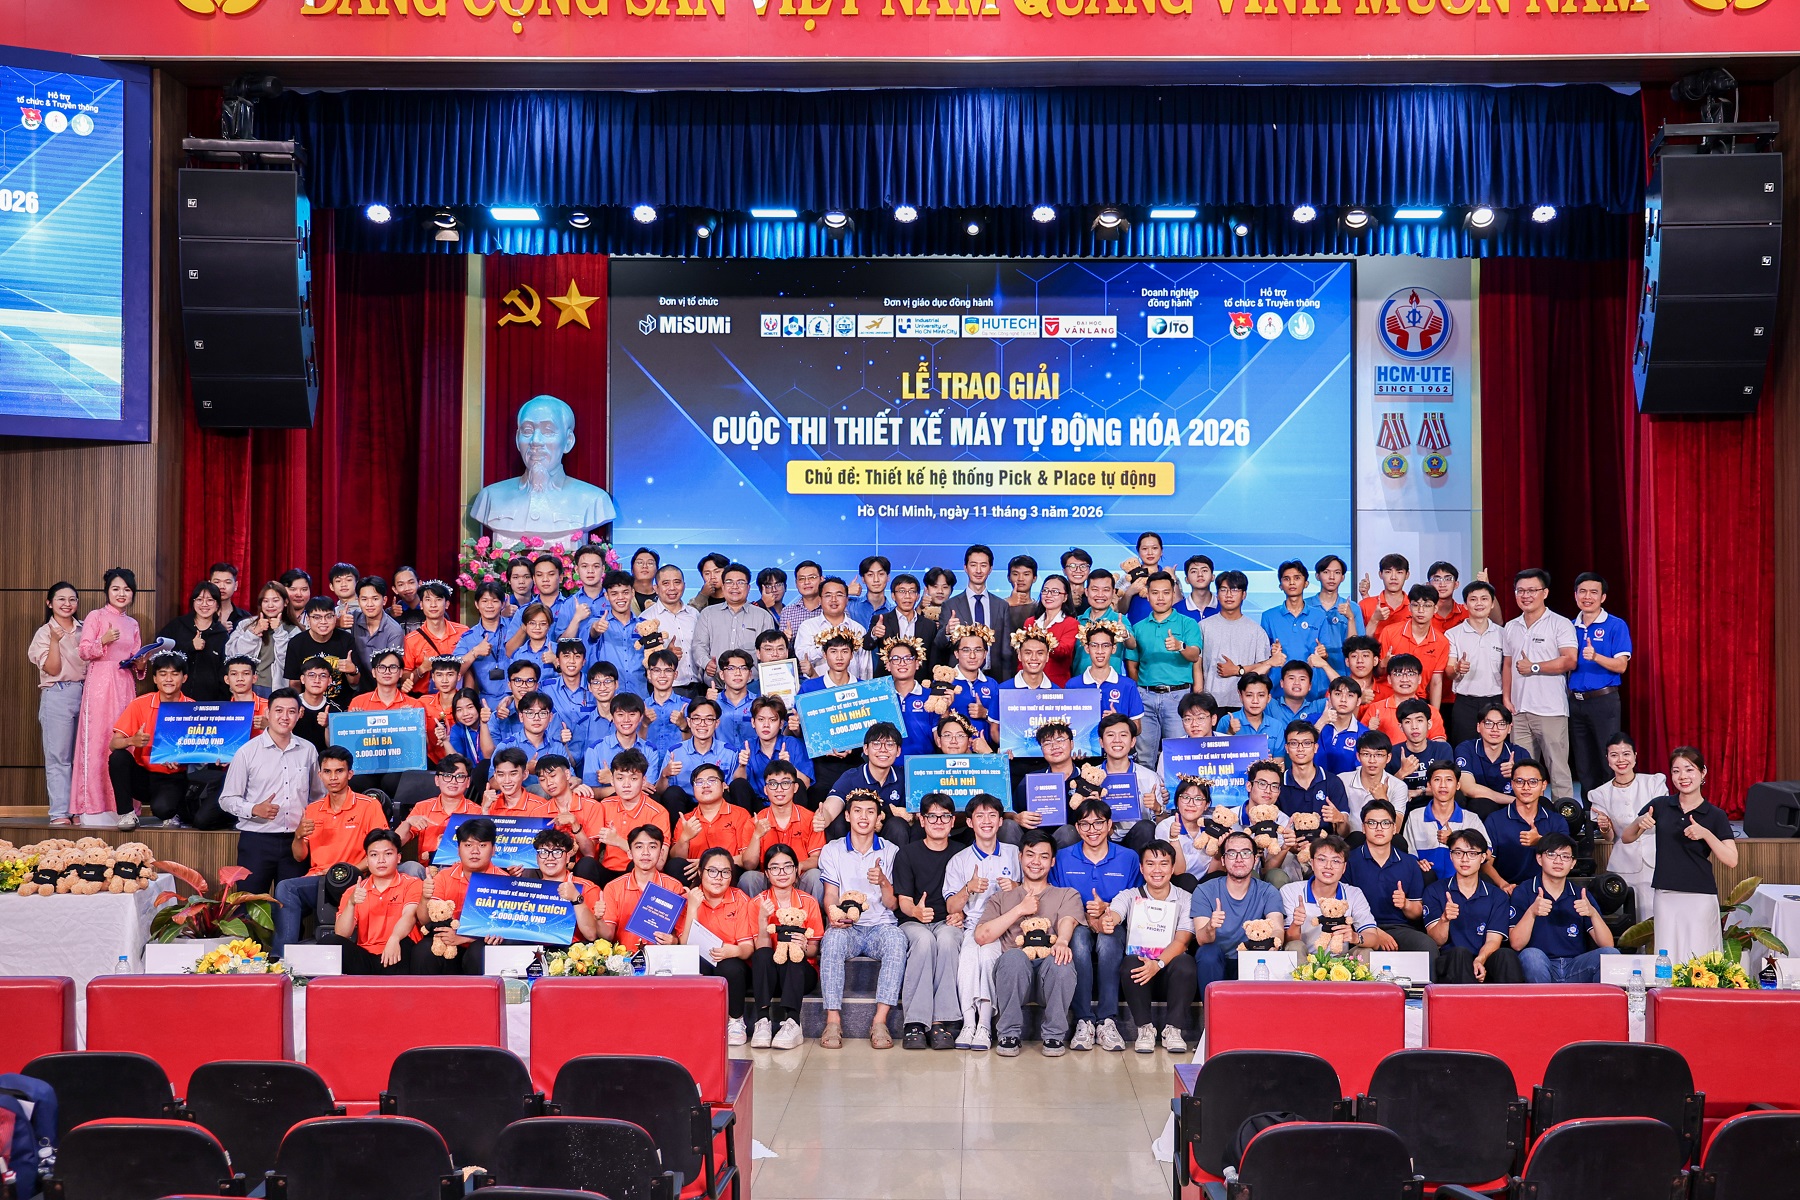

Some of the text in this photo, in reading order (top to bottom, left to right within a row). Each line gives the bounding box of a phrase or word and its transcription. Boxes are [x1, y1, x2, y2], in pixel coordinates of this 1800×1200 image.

[1142, 288, 1199, 299] Doanh nghiệp
[1274, 289, 1287, 299] trợ
[659, 296, 718, 307] Đơn vị tổ chức
[884, 297, 994, 308] Đơn vị giáo dục đồng hành
[1148, 298, 1192, 308] đồng hành
[1235, 299, 1256, 307] chức
[1258, 299, 1264, 307] &
[1266, 298, 1294, 309] Truyền
[1296, 299, 1320, 309] thông
[982, 318, 1037, 329] HUTECH
[1169, 323, 1188, 333] ITO
[902, 362, 1060, 400] LỄ TRAO GIẢI
[712, 408, 1250, 452] CUỘC THI THIẾT KẾ MÁY TỰ ĐỘNG HÓA 2026
[805, 467, 1156, 489] Chủ đề: Thiết kế hệ thống Pick & Place tự động
[857, 504, 1103, 521] Hồ Chí Minh, ngày 11 tháng 3 năm 2026
[830, 706, 871, 724] GIẢI NHẤT
[188, 724, 217, 734] GIẢI BA
[363, 735, 379, 746] GIẢI
[356, 749, 386, 758] 3.000.000
[1198, 762, 1234, 775] GIẢI NHÌ
[940, 775, 976, 786] GIẢI NHÌ
[475, 896, 567, 915] GIẢI KHUYẾN KHÍCH
[491, 912, 546, 923] 2.000.000 VNĐ
